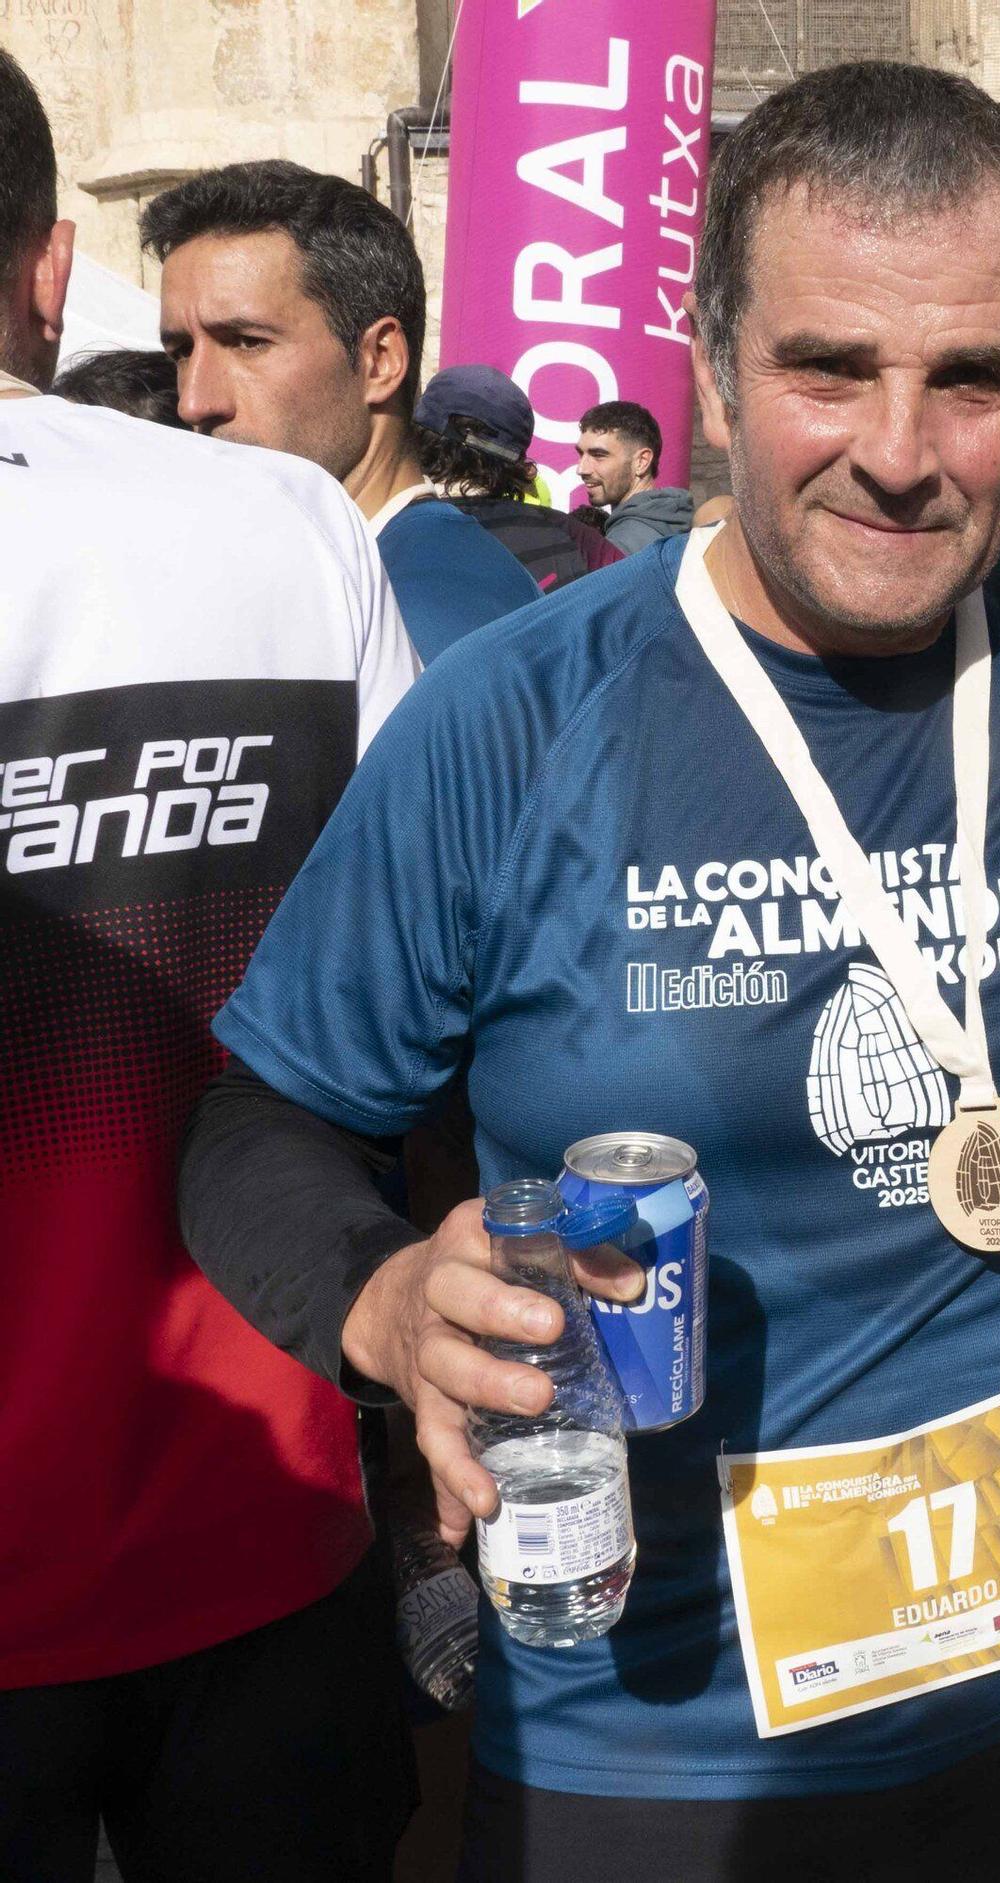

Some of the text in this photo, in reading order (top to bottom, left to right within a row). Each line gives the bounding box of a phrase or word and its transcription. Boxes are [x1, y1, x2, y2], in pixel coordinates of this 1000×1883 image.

[645, 54, 704, 345] kutxa
[0, 748, 107, 808] er
[627, 843, 962, 902] LA CONQIST
[627, 906, 668, 930] DE
[674, 903, 713, 928] LA
[627, 961, 788, 1013] II Edición
[851, 1140, 931, 1166] VITORI
[852, 1163, 929, 1190] GASTE
[878, 1185, 930, 1208] 2025
[815, 1472, 881, 1492] CONQUISTA
[822, 1474, 903, 1503] ALMENDRA
[867, 1480, 922, 1503] KONKISTA
[888, 1480, 978, 1592] 17
[892, 1578, 999, 1628] EDUARDO
[795, 1664, 835, 1684] Diario
